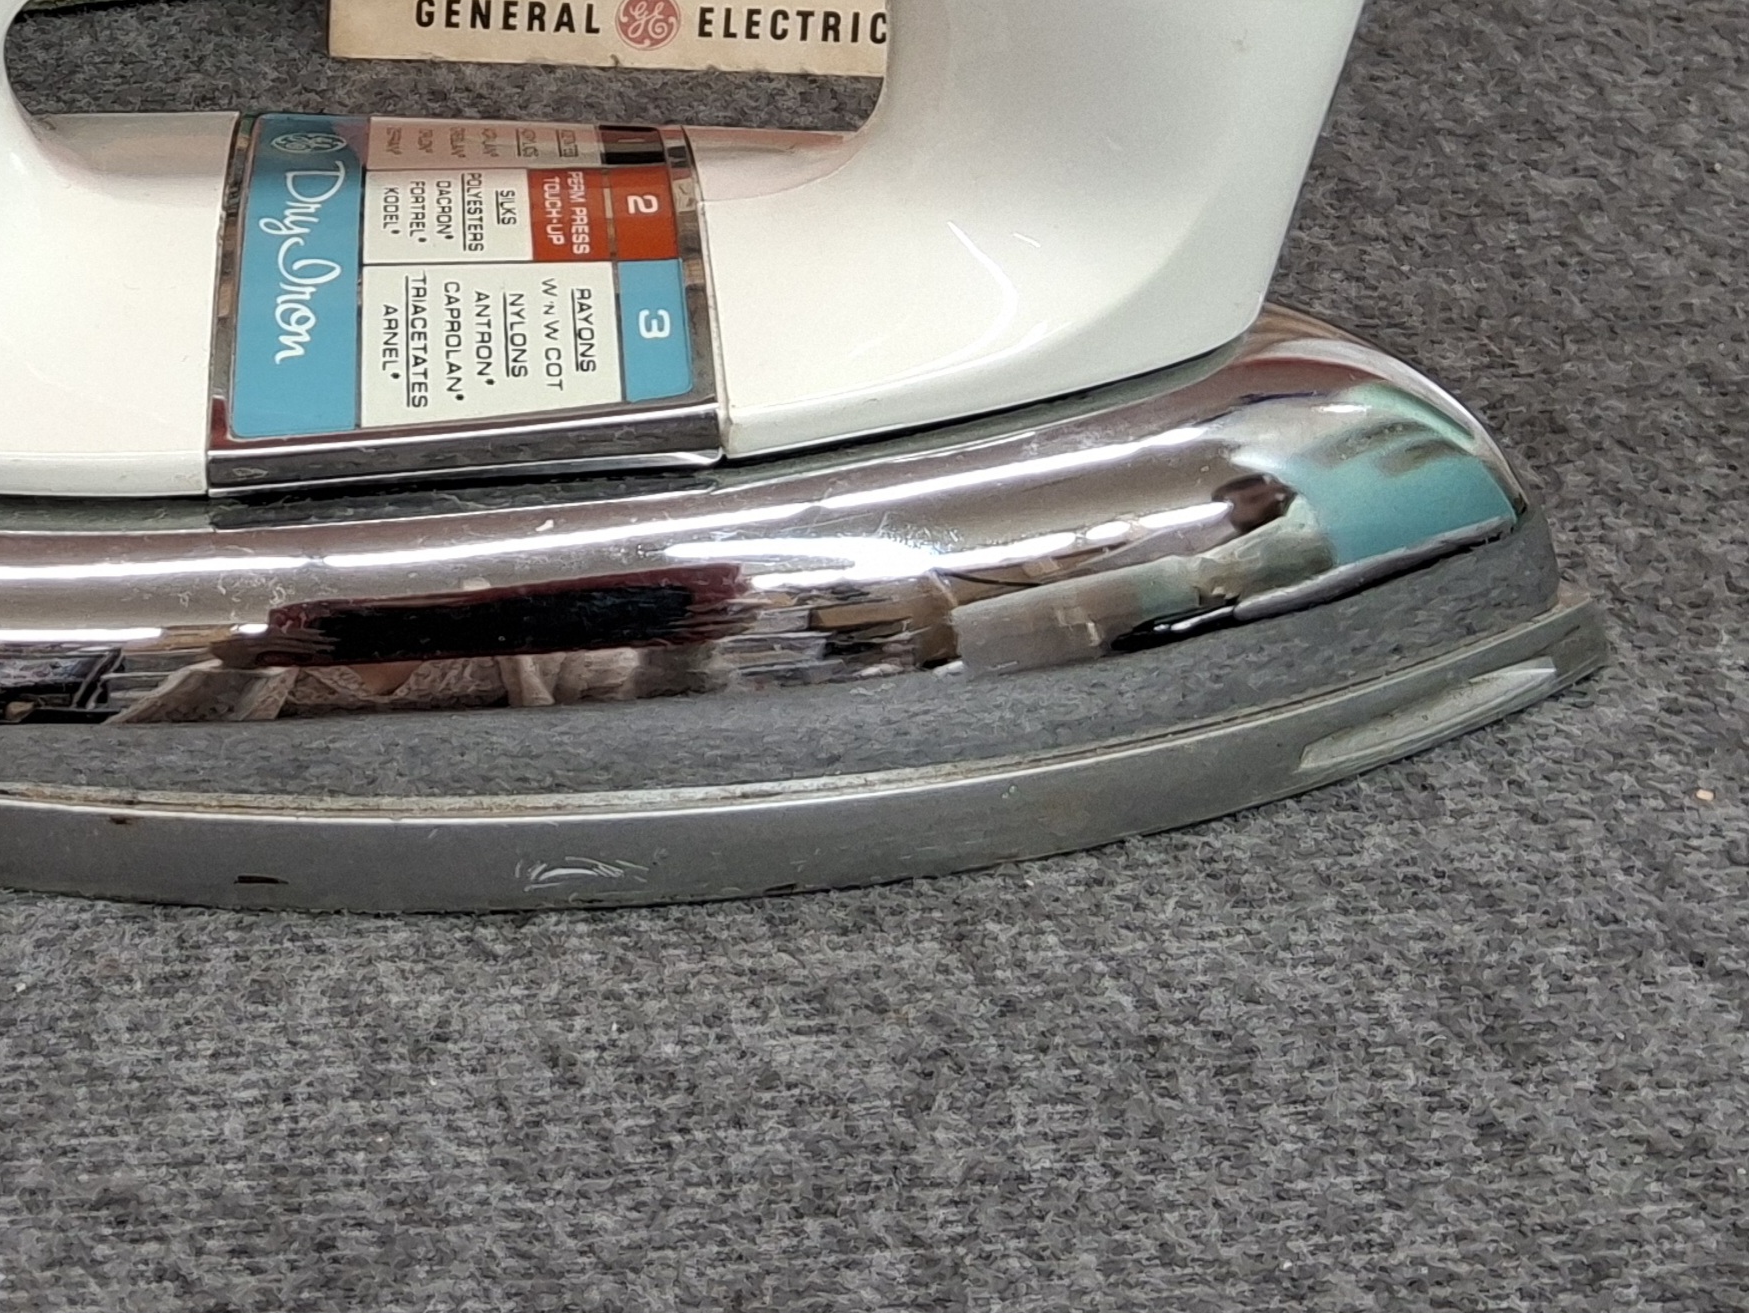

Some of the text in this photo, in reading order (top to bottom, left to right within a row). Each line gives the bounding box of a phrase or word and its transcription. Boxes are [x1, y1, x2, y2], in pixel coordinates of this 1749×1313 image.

[697, 6, 887, 44] ELECTRIC
[500, 190, 517, 225] SILKS
[567, 171, 588, 203] PERM
[627, 193, 658, 214] 2
[466, 173, 484, 252] POLYESTERS
[543, 176, 564, 245] TOUCH-UP
[571, 207, 591, 254] PRESS
[259, 160, 346, 365] Dry Iron
[542, 278, 558, 298] W
[411, 272, 428, 408] TRIACETATES
[510, 293, 527, 378] NYLONS
[543, 321, 559, 340] W
[576, 288, 596, 372] RAYONS
[638, 308, 670, 339] 3
[544, 348, 563, 391] COT
